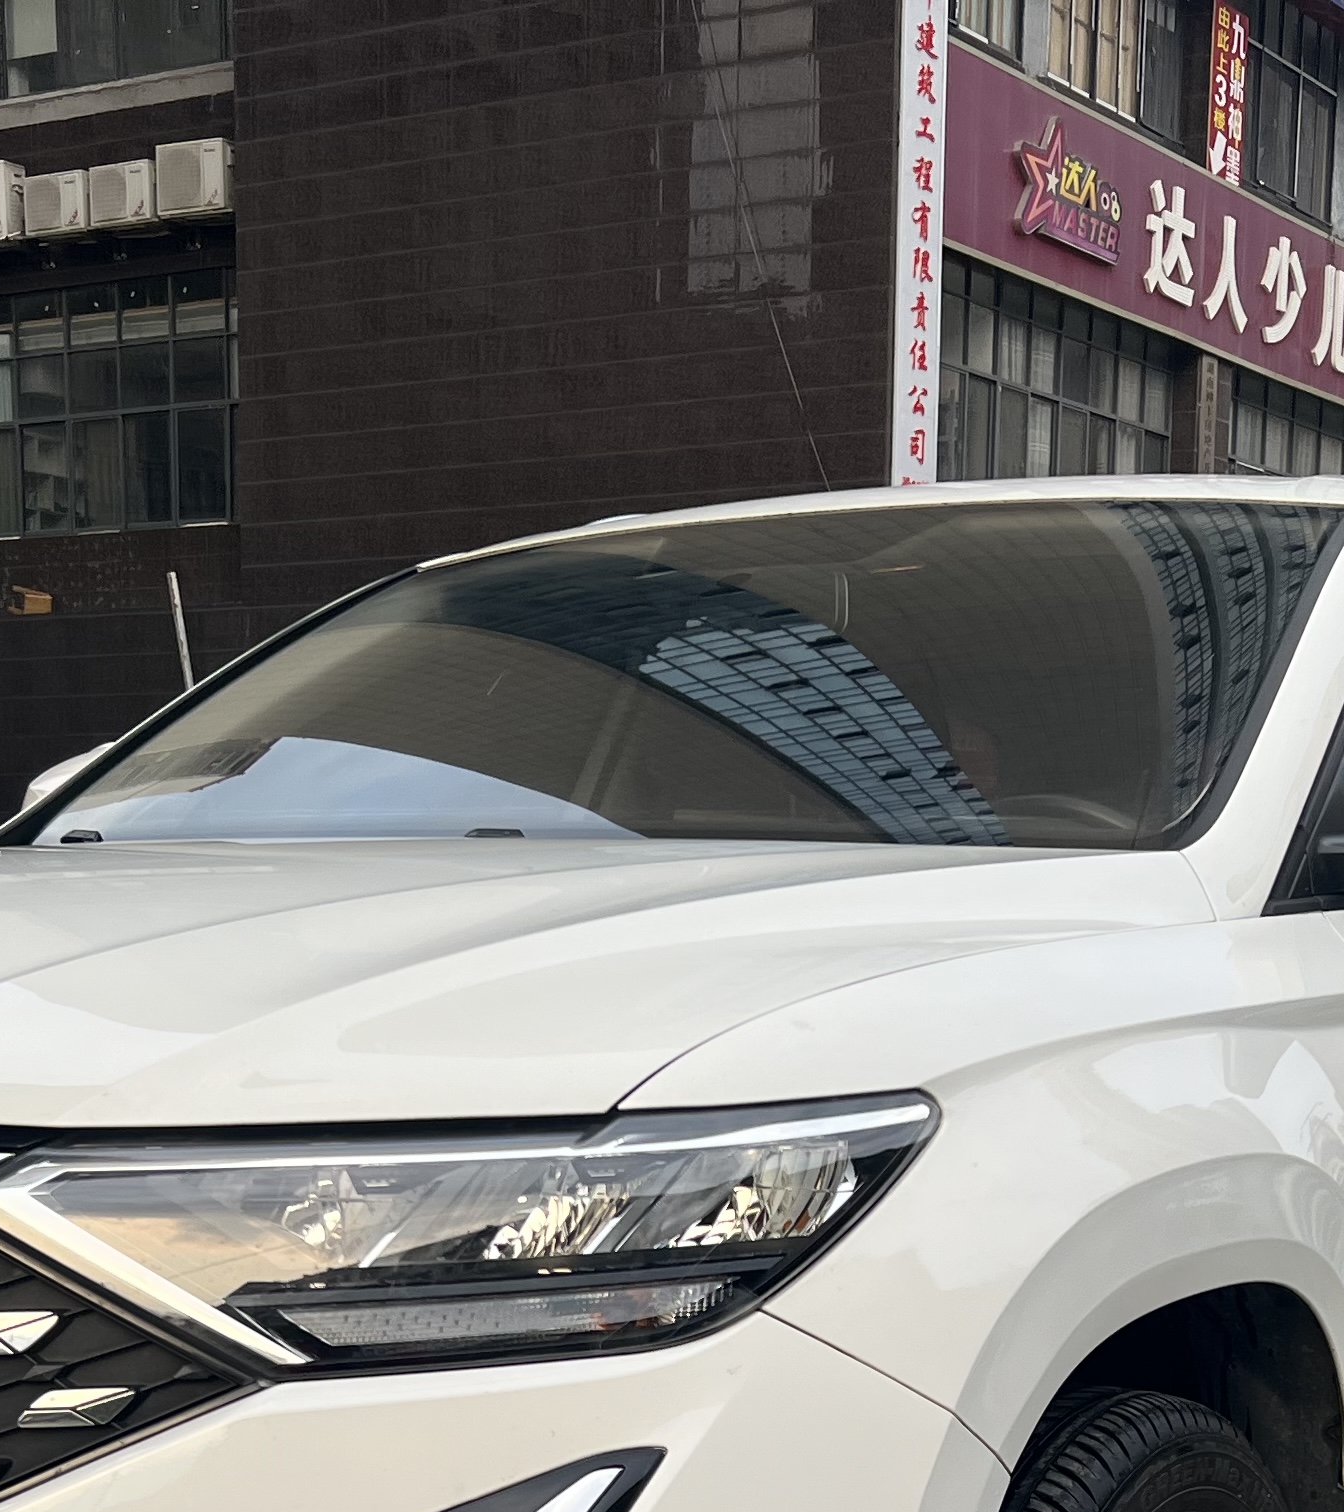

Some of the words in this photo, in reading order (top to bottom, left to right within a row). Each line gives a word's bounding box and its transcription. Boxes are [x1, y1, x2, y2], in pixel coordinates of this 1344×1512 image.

[1213, 6, 1231, 131] 由此上3楼
[909, 0, 940, 466] 建筑工程有限责任公司
[1052, 200, 1119, 252] MASTER
